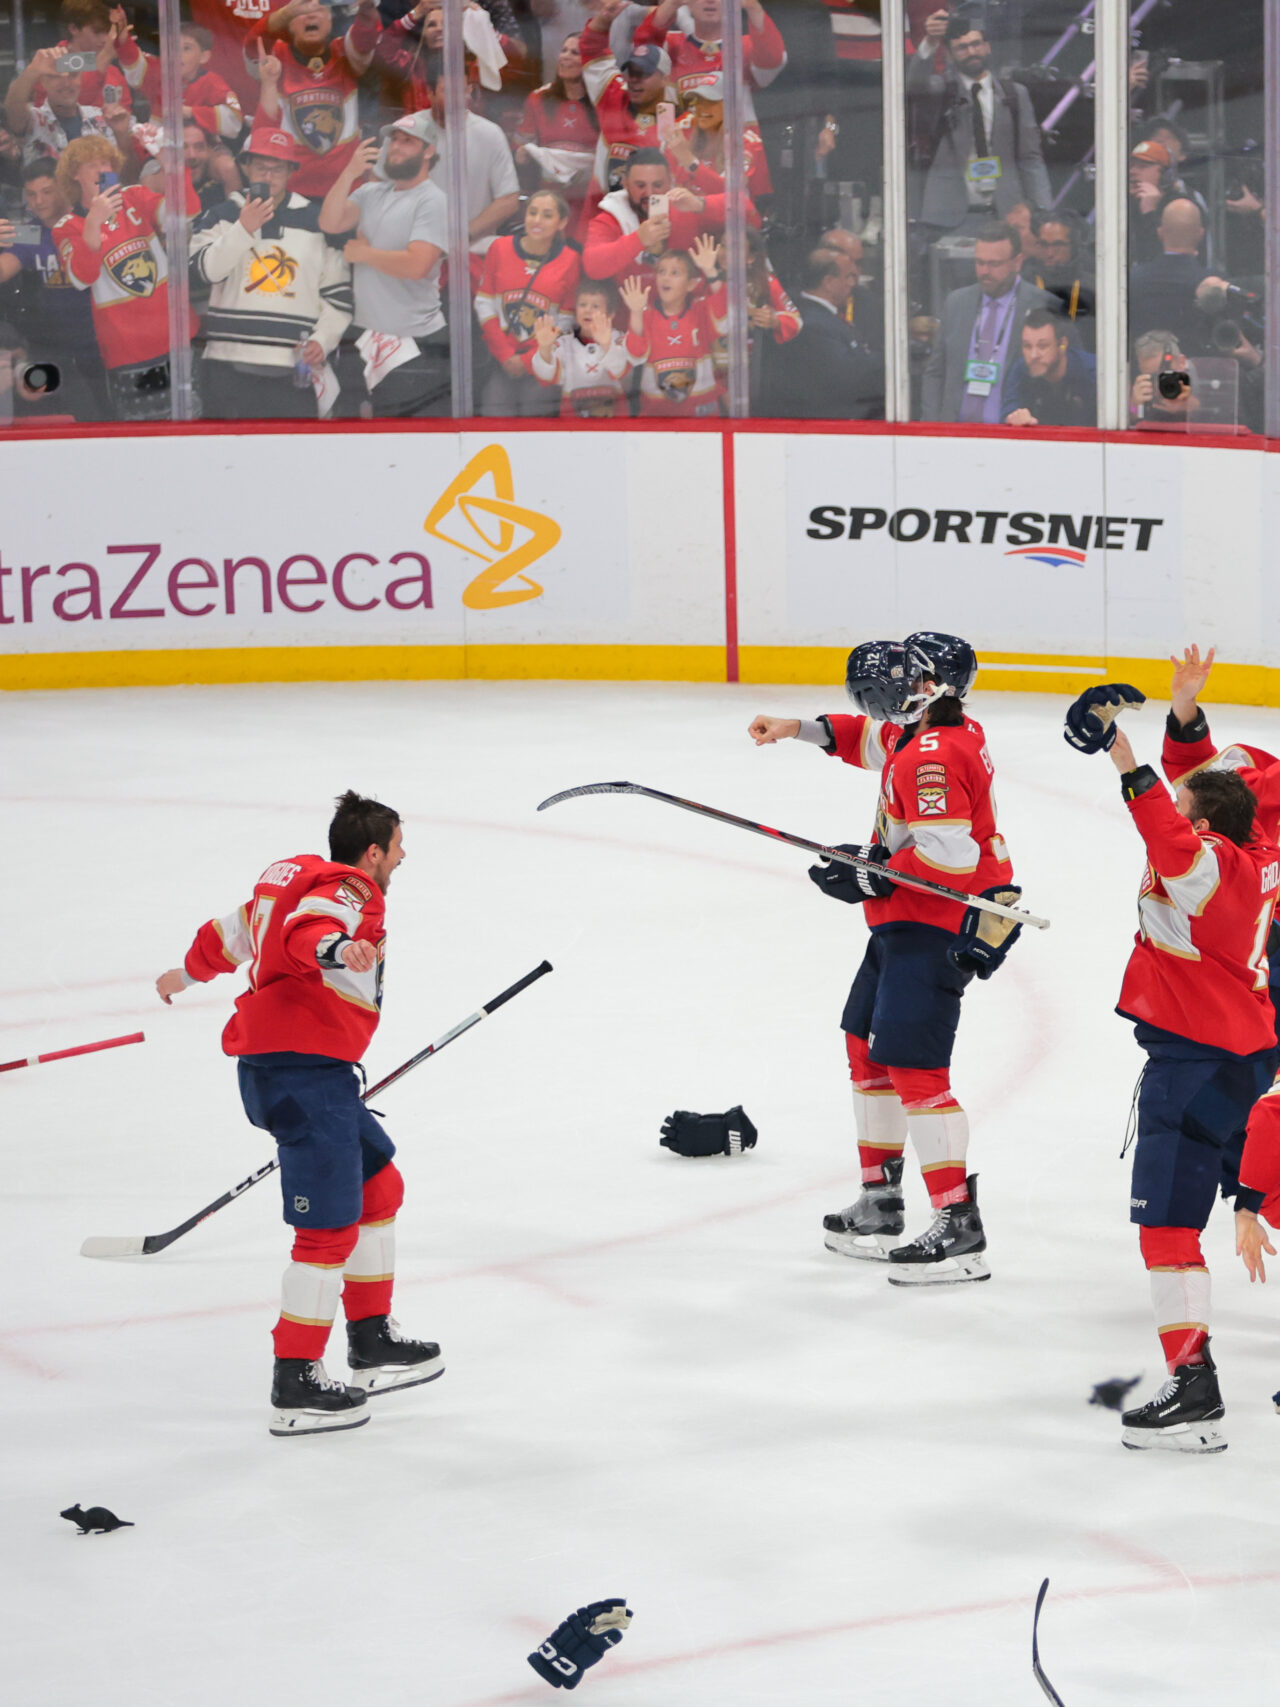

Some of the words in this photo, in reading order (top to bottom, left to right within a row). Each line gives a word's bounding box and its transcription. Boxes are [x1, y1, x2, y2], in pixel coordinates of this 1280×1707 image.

[126, 207, 142, 226] C
[806, 505, 1164, 552] SPORTSNET
[919, 731, 940, 753] 5
